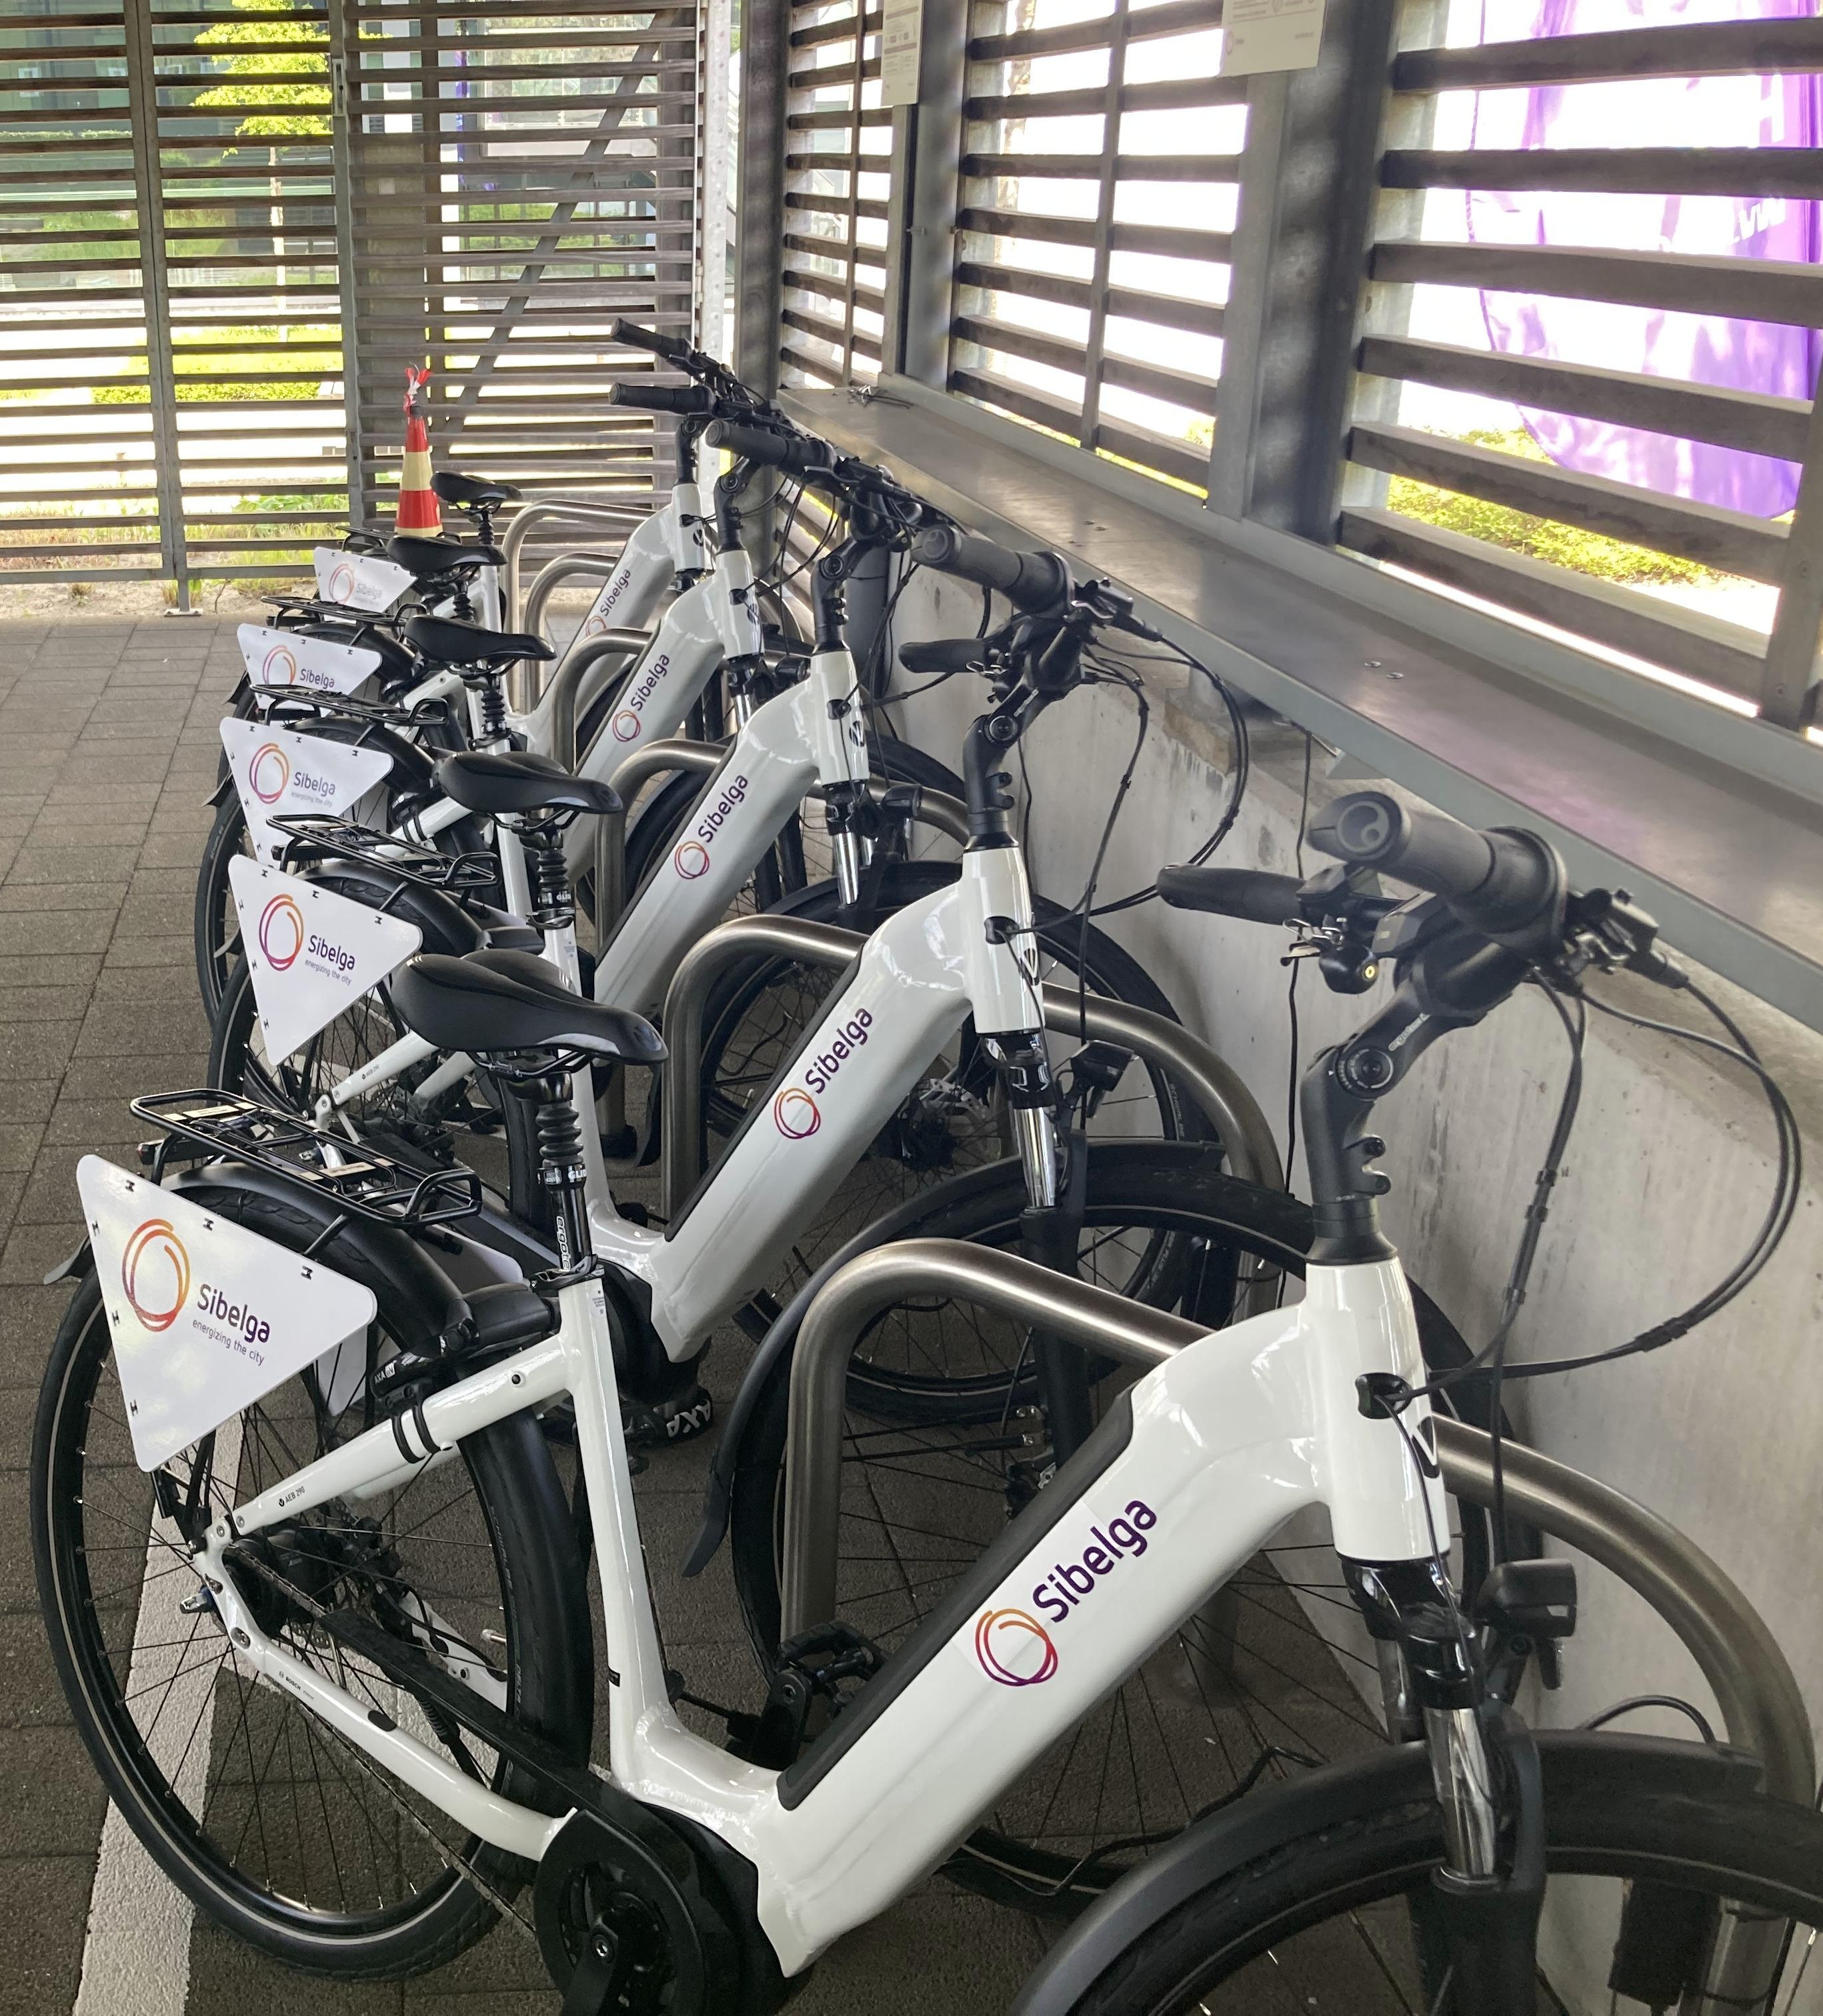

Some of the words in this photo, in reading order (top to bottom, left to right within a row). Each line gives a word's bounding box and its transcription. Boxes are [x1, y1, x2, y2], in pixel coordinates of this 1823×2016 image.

[356, 583, 383, 599] Sibelga
[601, 569, 631, 617] Sibelga
[300, 669, 335, 689] Sibelga
[631, 654, 669, 711] Sibelga
[293, 772, 335, 797] Sibelga
[698, 775, 748, 843] Sibelga
[305, 959, 331, 978] energizing
[331, 969, 341, 979] the
[341, 975, 352, 986] city
[308, 935, 355, 971] Sibelga
[805, 1008, 873, 1094] Sibelga
[556, 1216, 571, 1272] ergote
[197, 1283, 270, 1343] Sibelga
[193, 1319, 231, 1349] energizing
[233, 1340, 247, 1355] the
[249, 1350, 264, 1366] city
[285, 1492, 296, 1503] AEB
[1032, 1500, 1157, 1623] Sibelga
